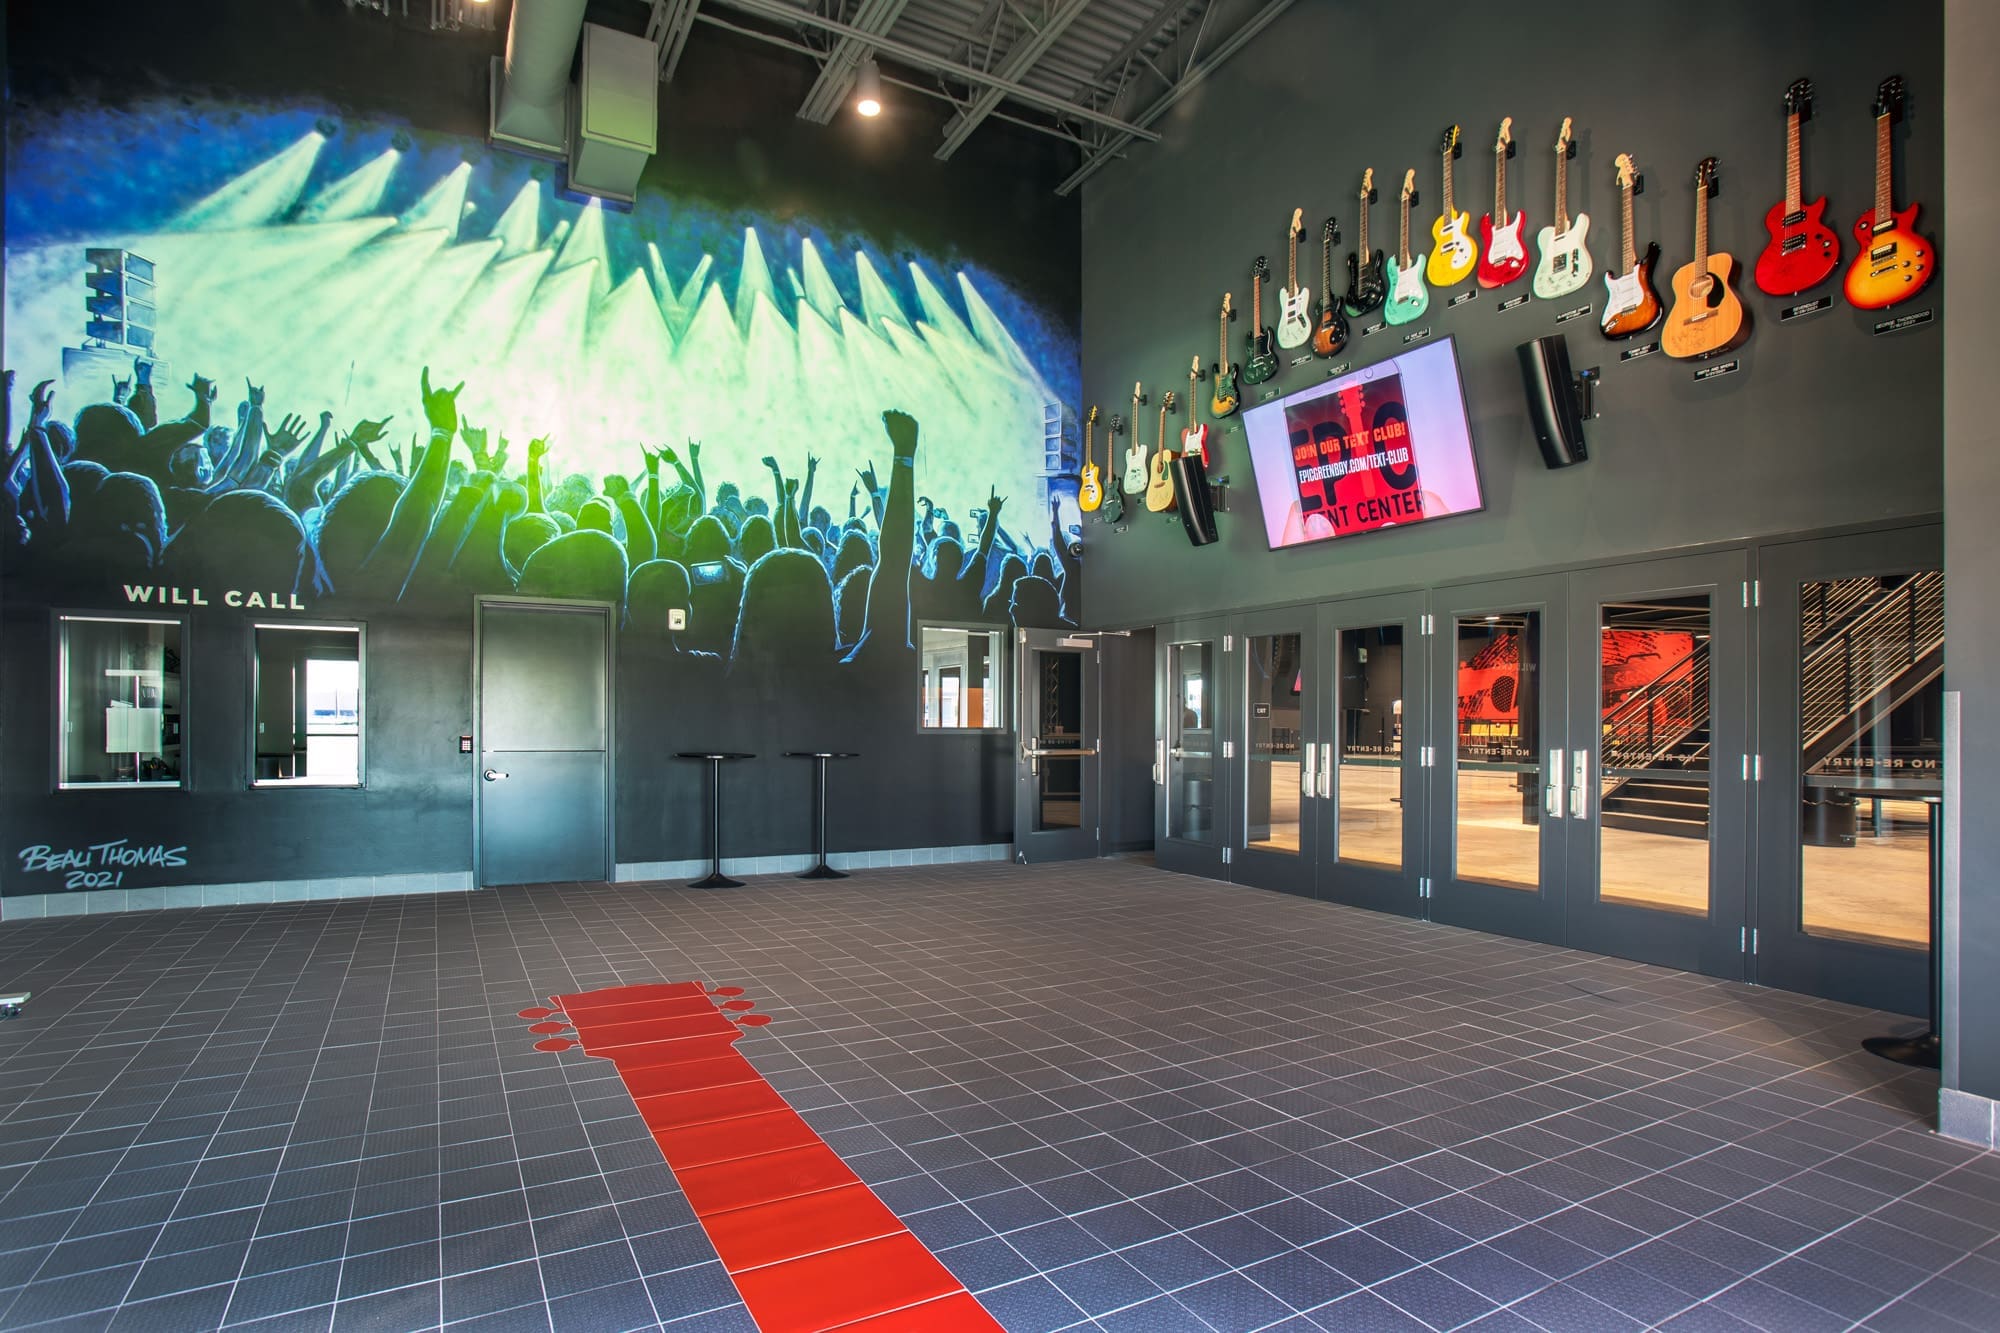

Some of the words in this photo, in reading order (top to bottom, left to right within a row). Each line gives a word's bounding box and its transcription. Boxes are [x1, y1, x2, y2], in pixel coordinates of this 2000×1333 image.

[1295, 444, 1318, 460] JOIN
[1320, 438, 1341, 454] OUR
[1343, 431, 1369, 449] TEXT
[1373, 422, 1406, 442] CLUB!
[1299, 447, 1409, 484] EPICGREENBAY.COM/TEXT-CLUB
[123, 584, 209, 606] WILL
[224, 590, 305, 610] CALL
[18, 845, 92, 872] BEAU
[89, 838, 188, 867] THOMAS
[64, 871, 124, 889] 2021
